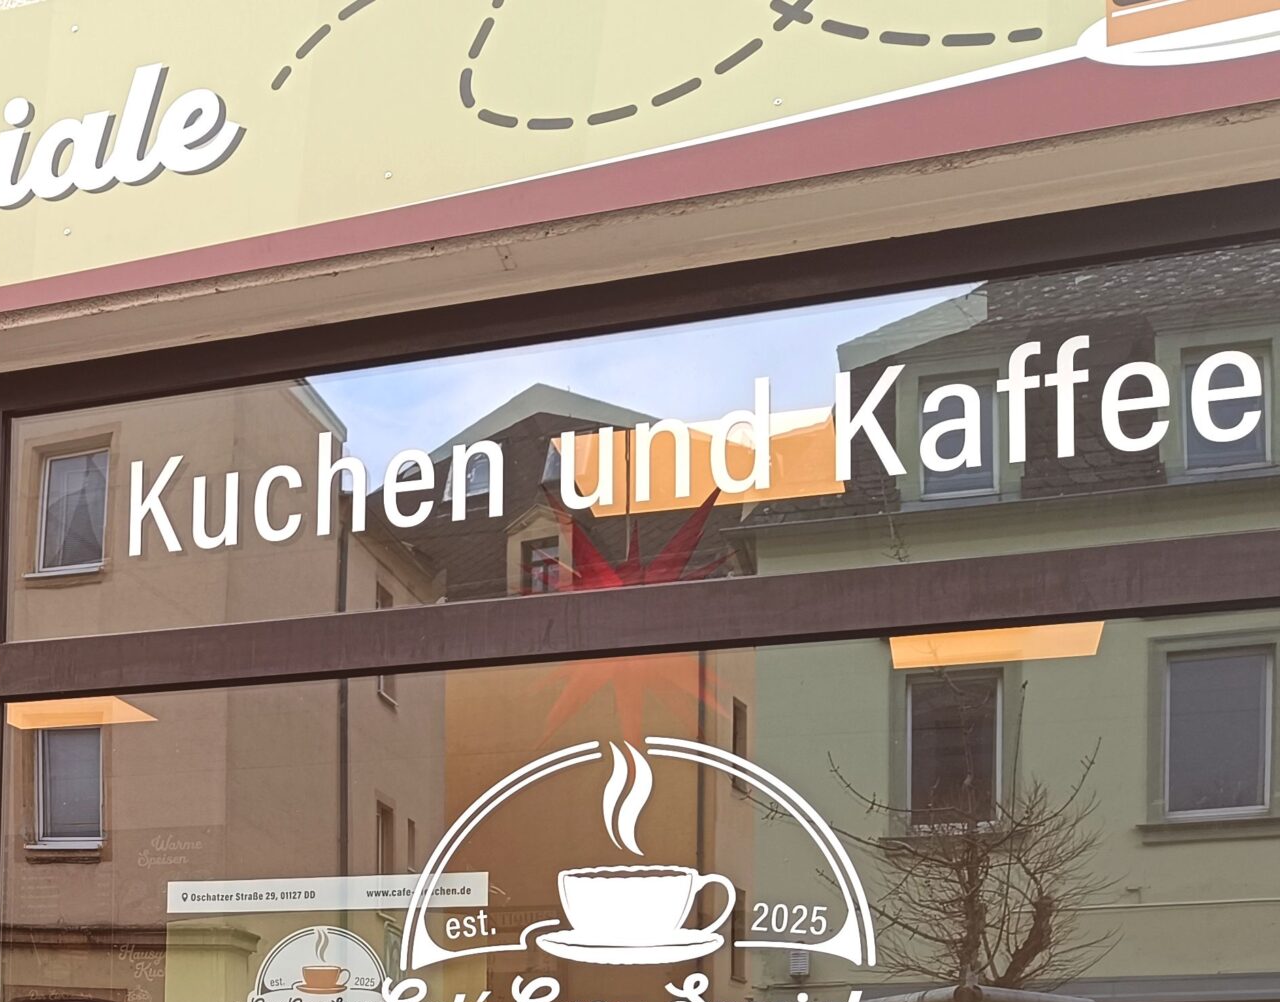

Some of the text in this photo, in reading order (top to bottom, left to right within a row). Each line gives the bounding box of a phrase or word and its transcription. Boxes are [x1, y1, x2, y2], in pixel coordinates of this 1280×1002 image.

[127, 335, 1265, 557] Kuchen und Kaffee
[190, 889, 316, 902] Oschatzer Straße 29, 01127 DD
[445, 908, 498, 941] est.
[750, 902, 829, 936] 2025
[270, 976, 375, 987] est. 2025
